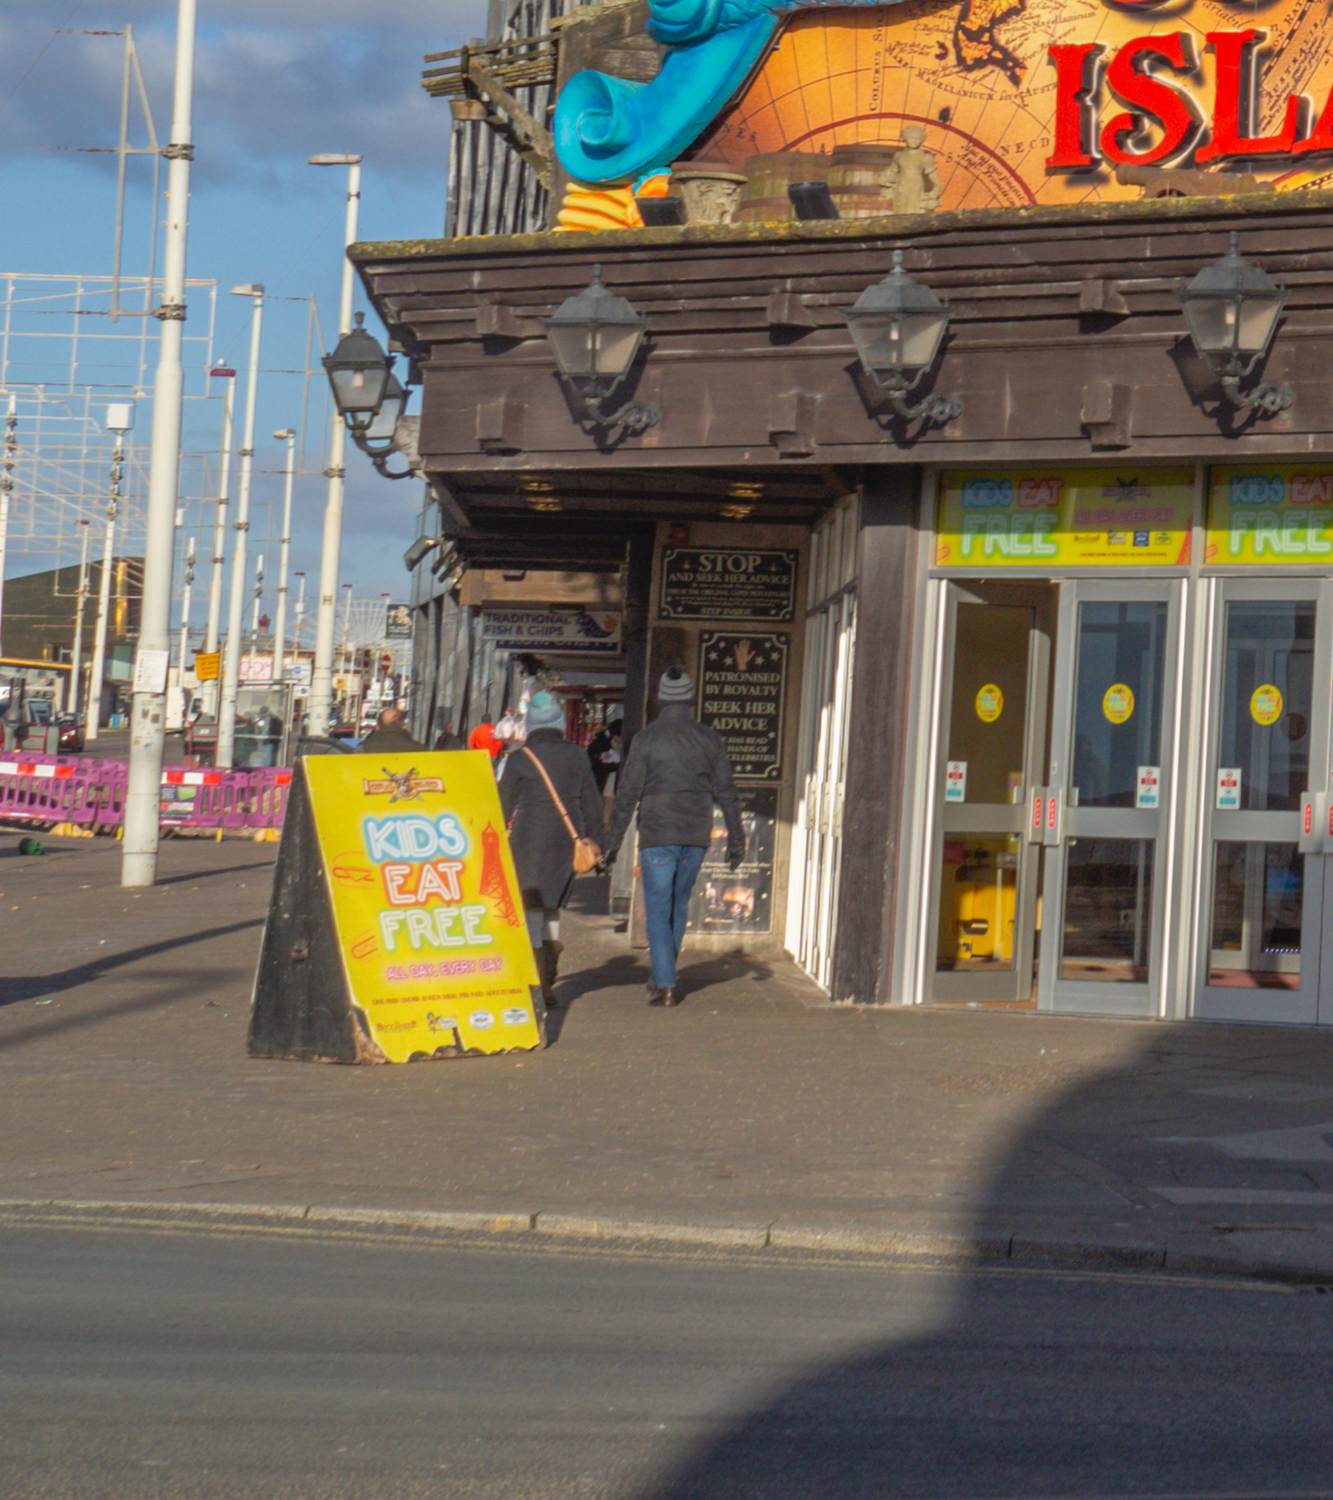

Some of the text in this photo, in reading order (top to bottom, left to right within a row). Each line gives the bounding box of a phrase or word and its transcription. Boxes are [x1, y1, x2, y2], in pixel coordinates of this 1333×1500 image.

[962, 479, 1062, 507] KIDS EAT
[1230, 476, 1285, 503] KIDS
[961, 513, 1058, 555] FREE
[1229, 510, 1332, 553] FREE
[699, 553, 762, 573] STOP
[668, 572, 790, 584] AND SEEK HER ADVICE
[485, 613, 571, 624] TRADITIONAL
[484, 624, 564, 636] FISH & CHIPS
[705, 671, 781, 683] PATRONISED
[705, 684, 779, 696] BY ROYALTY
[703, 701, 776, 715] SEEK HER
[710, 717, 768, 730] ADVICE
[367, 817, 466, 860] KIDS
[384, 862, 463, 904] EAT
[379, 905, 492, 950] FREE
[387, 957, 503, 981] ALL DAY, EVERY DAY
